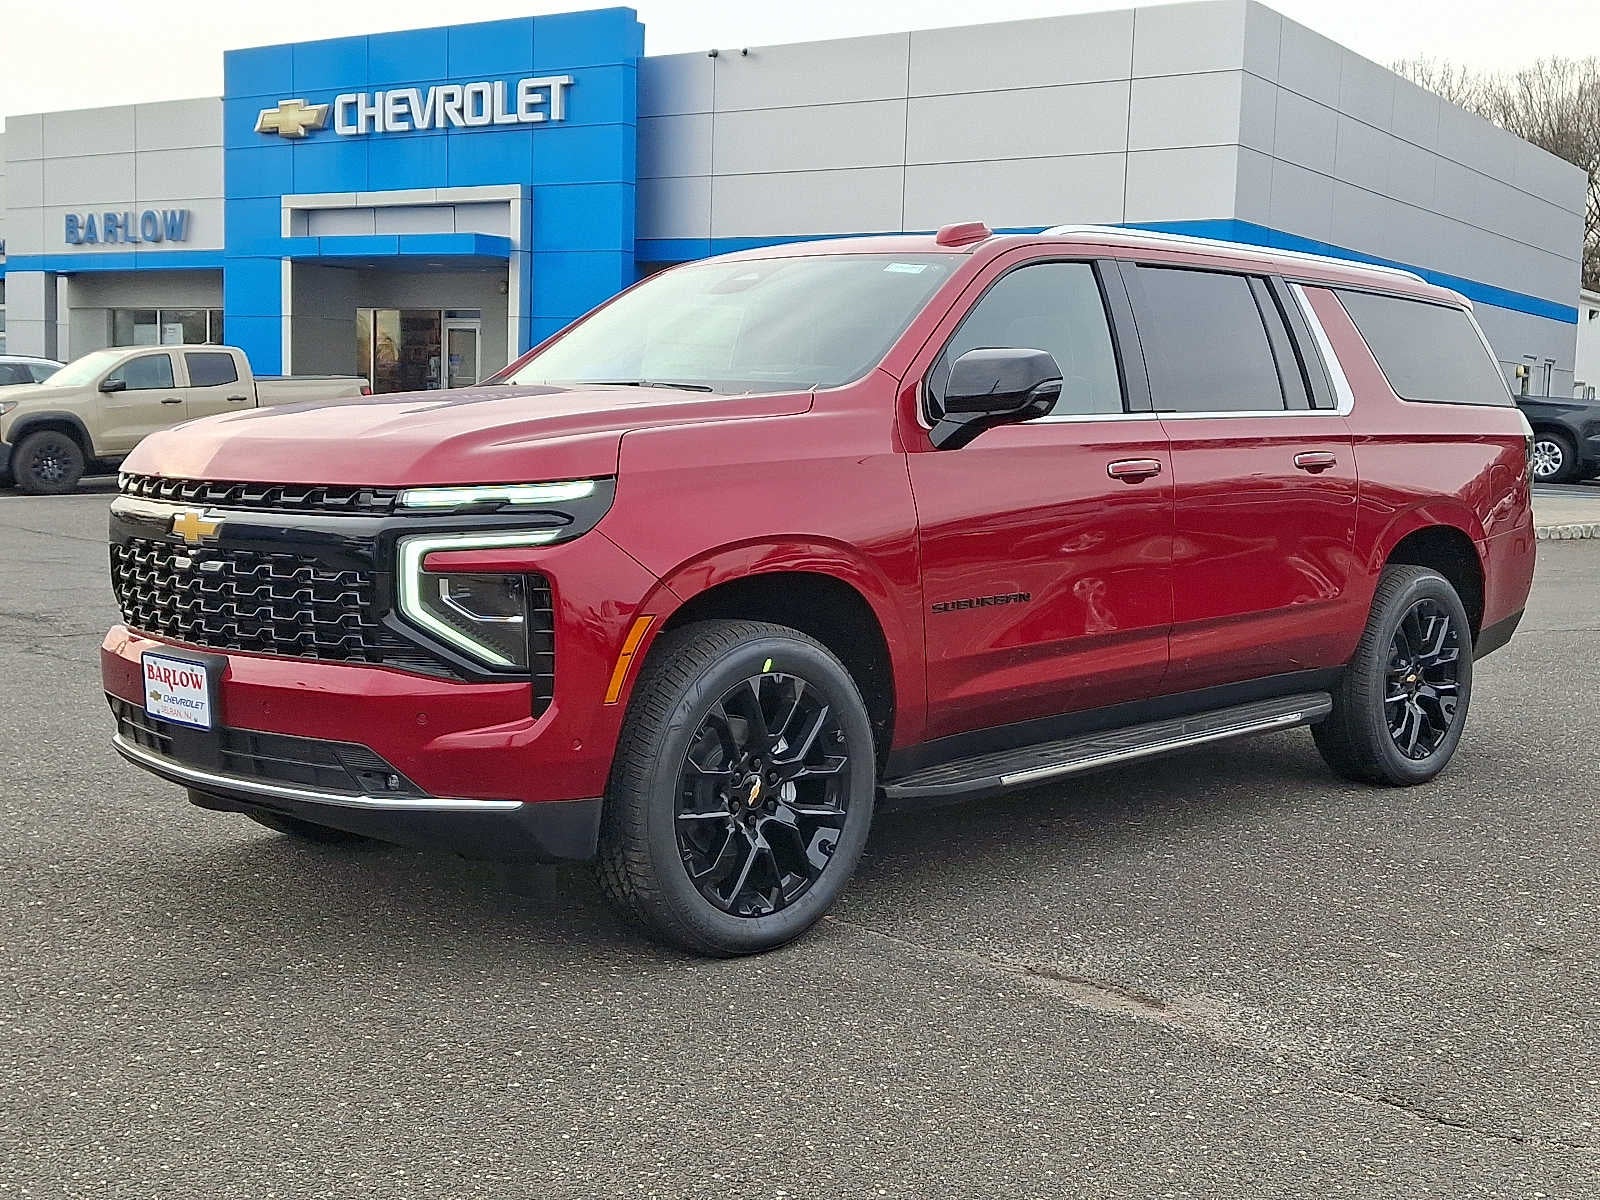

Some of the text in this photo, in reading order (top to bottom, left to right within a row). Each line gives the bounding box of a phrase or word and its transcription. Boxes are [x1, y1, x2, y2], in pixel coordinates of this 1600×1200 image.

[334, 74, 575, 136] CHEVROLET
[65, 208, 191, 245] BARLOW
[931, 592, 1031, 614] SUBURBAN
[147, 664, 203, 692] BARLOW
[163, 694, 205, 710] CHEVROLET
